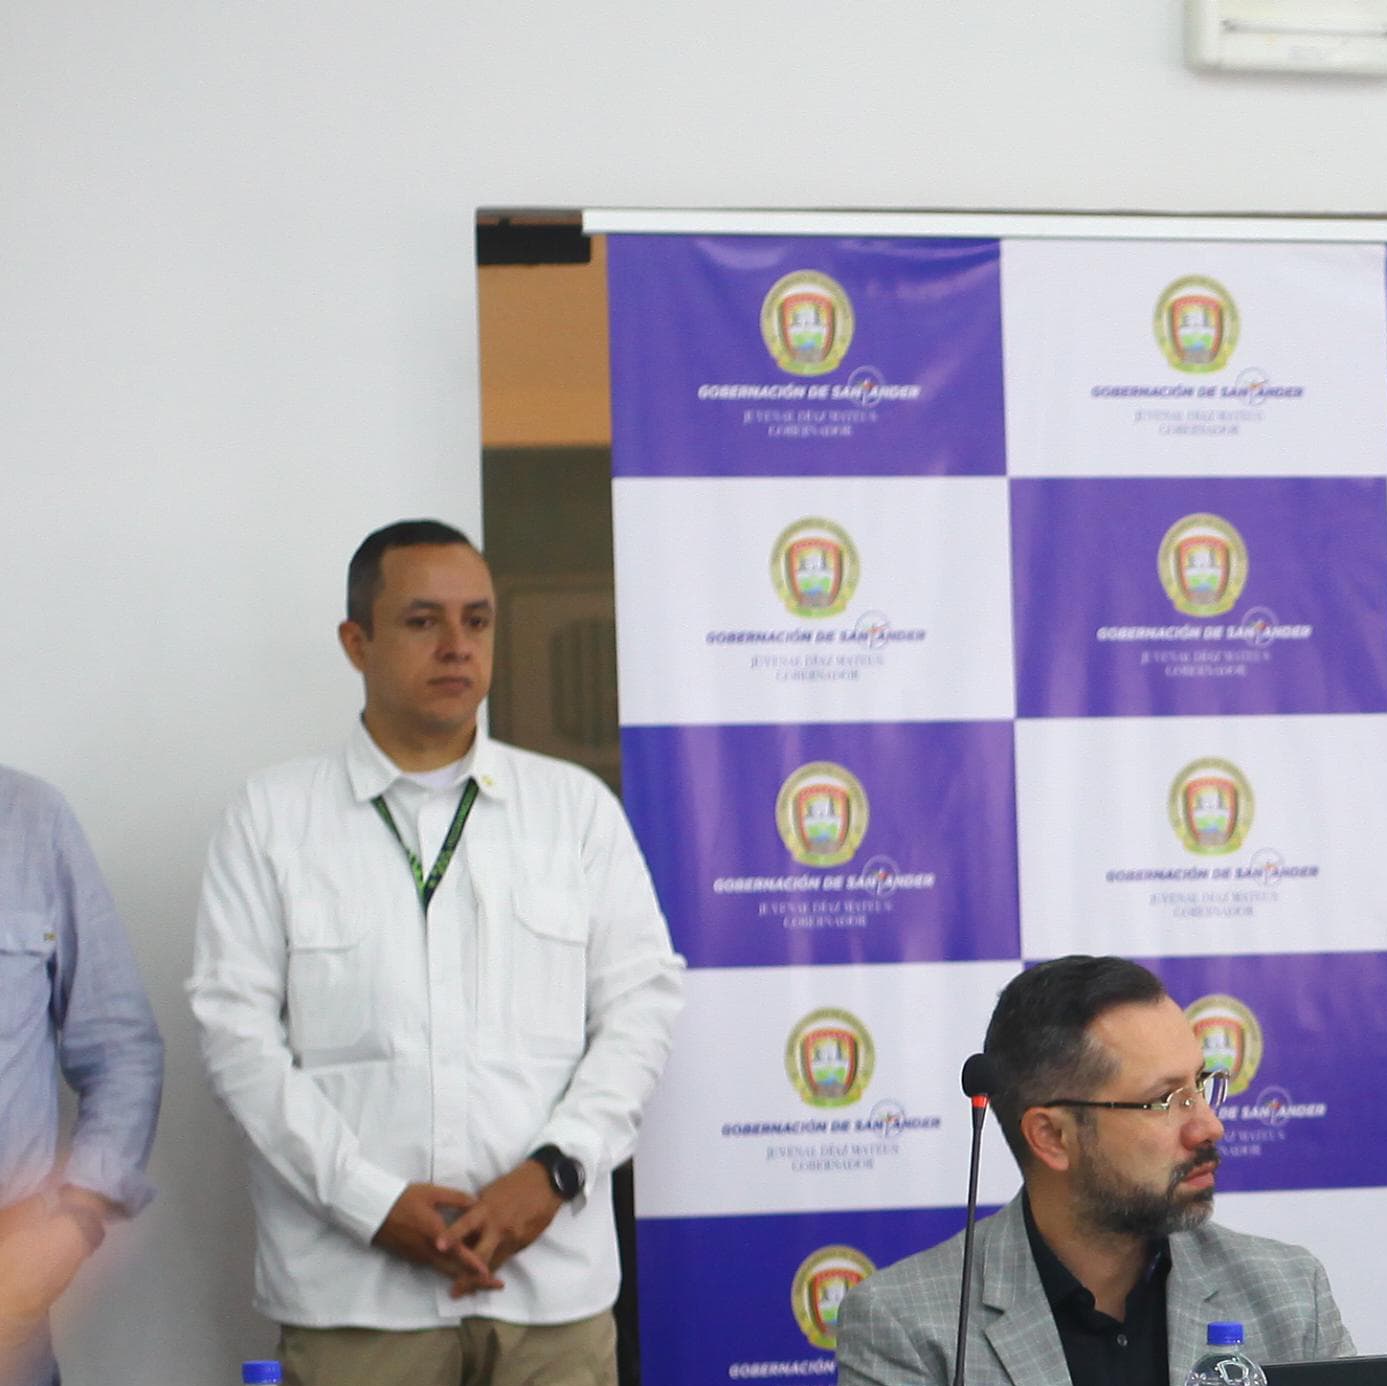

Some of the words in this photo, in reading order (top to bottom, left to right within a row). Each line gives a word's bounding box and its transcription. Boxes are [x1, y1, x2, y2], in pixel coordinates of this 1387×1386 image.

[808, 385, 829, 399] DE
[1198, 386, 1216, 397] DE
[815, 631, 834, 642] DE
[1203, 626, 1222, 639] DE
[1212, 867, 1230, 879] DE
[713, 875, 820, 893] GOBERNACIÓN
[823, 876, 843, 891] DE
[846, 870, 935, 893] SANTANDER
[721, 1119, 826, 1136] GOBERNACIÓN
[830, 1121, 849, 1132] DE
[855, 1115, 941, 1134] SANTANDER
